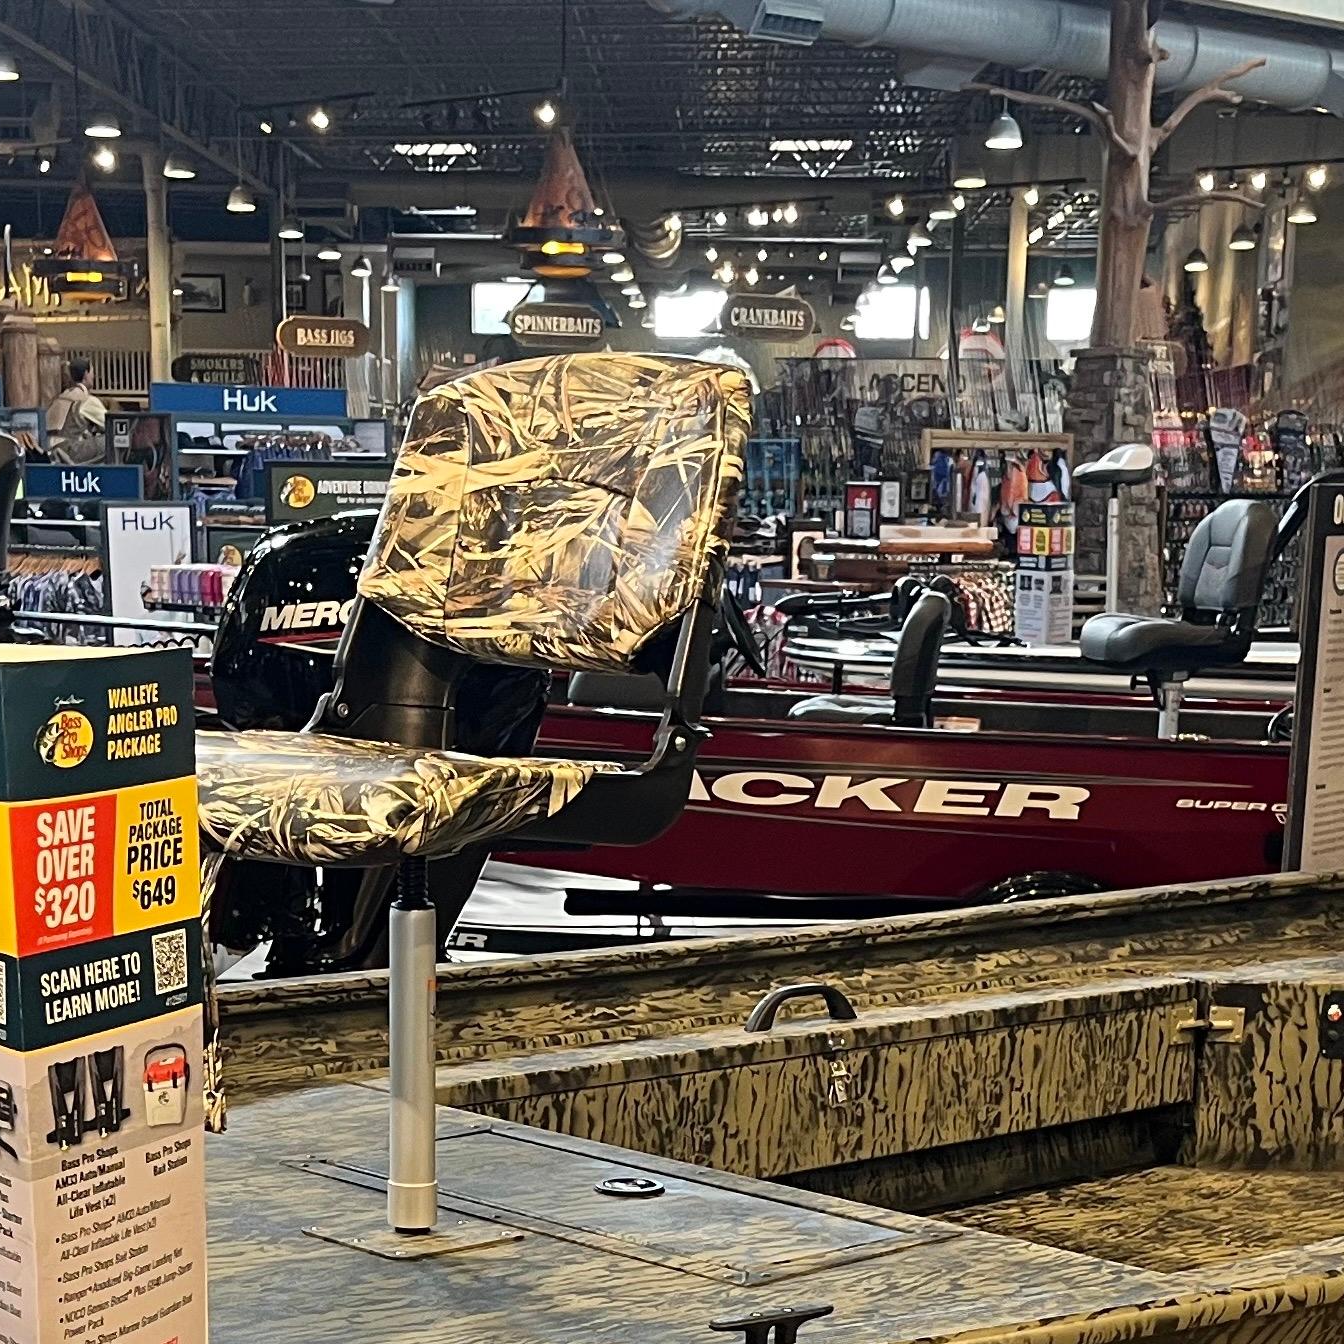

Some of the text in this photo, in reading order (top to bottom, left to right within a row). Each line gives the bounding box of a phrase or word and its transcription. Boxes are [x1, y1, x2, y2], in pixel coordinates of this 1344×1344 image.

[514, 315, 601, 335] SPINNERBAITS
[730, 307, 805, 328] CRANKBAITS
[296, 328, 355, 346] BASS JIGS
[190, 358, 245, 370] SMOKERS
[223, 388, 278, 413] Huk
[61, 471, 101, 493] Huk
[121, 512, 175, 532] Huk
[107, 682, 159, 709] WALLEYE
[107, 703, 179, 736] ANGLER PRO
[107, 732, 162, 761] PACKAGE
[139, 798, 174, 822] TOTAL
[1176, 798, 1268, 812] SUPER
[36, 805, 96, 848] SAVE
[128, 816, 183, 844] PACKAGE
[36, 843, 95, 885] OVER
[127, 837, 183, 875] PRICE
[34, 880, 96, 929] $320
[132, 875, 176, 910] $649
[40, 951, 142, 997] SCAN HERE TO
[44, 995, 93, 1025] LEARN
[94, 979, 142, 1012] MORE!
[61, 1157, 81, 1172] Bass
[81, 1152, 95, 1166] Pro
[69, 1205, 84, 1220] Life
[84, 1199, 103, 1214] Vest
